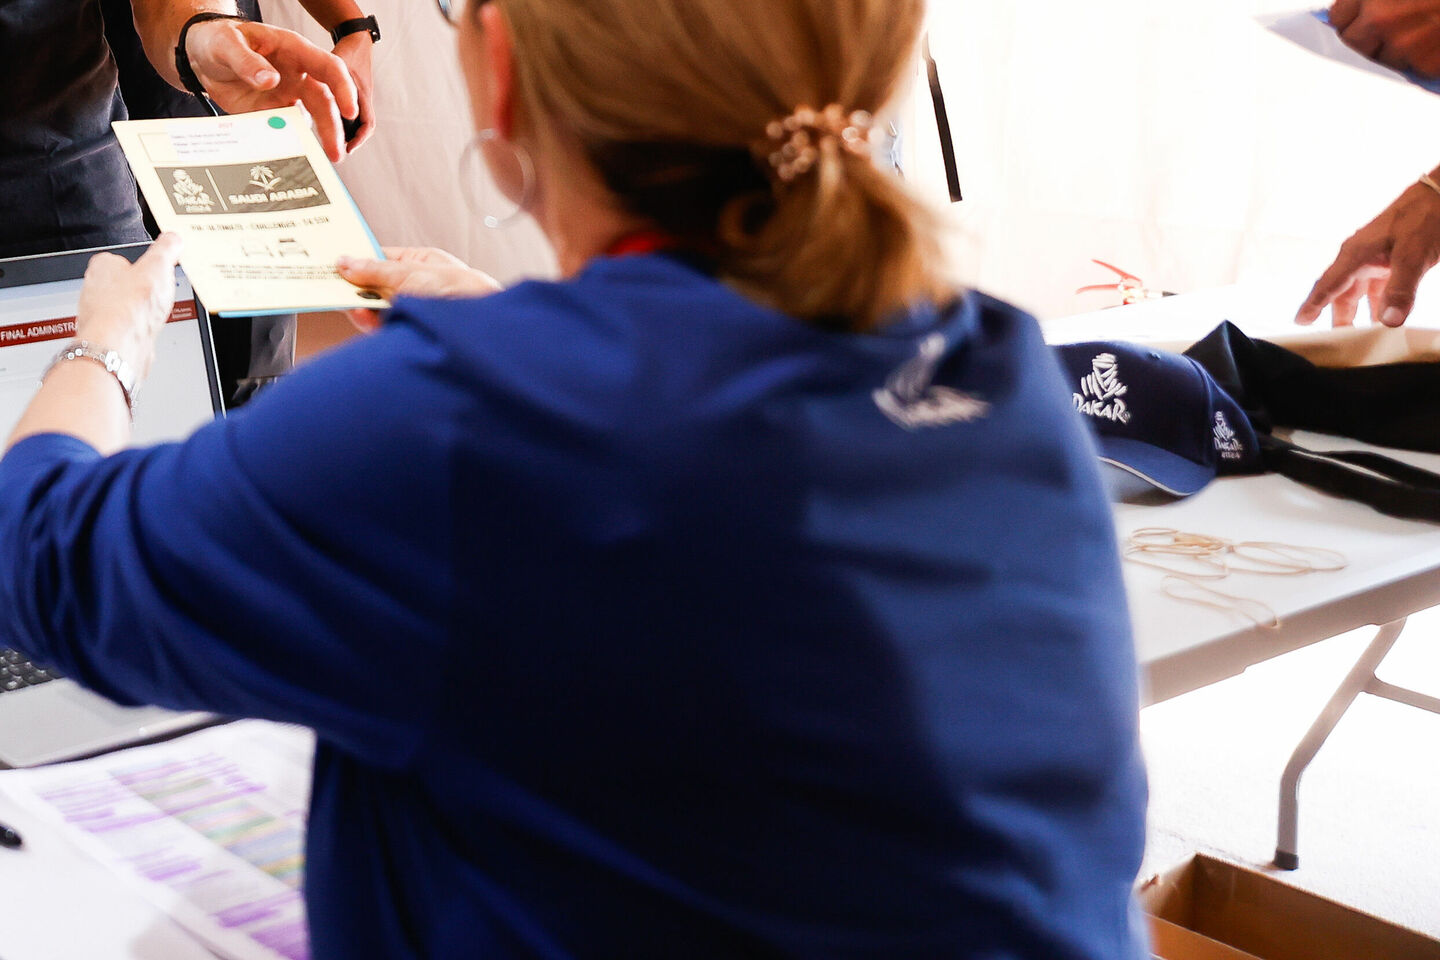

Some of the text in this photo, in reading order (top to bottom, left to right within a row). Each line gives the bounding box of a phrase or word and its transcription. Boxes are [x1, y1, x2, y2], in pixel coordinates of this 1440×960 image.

[228, 186, 319, 205] SAUDI ARABIA
[0, 328, 26, 342] FINAL
[1072, 392, 1128, 424] DAKAR
